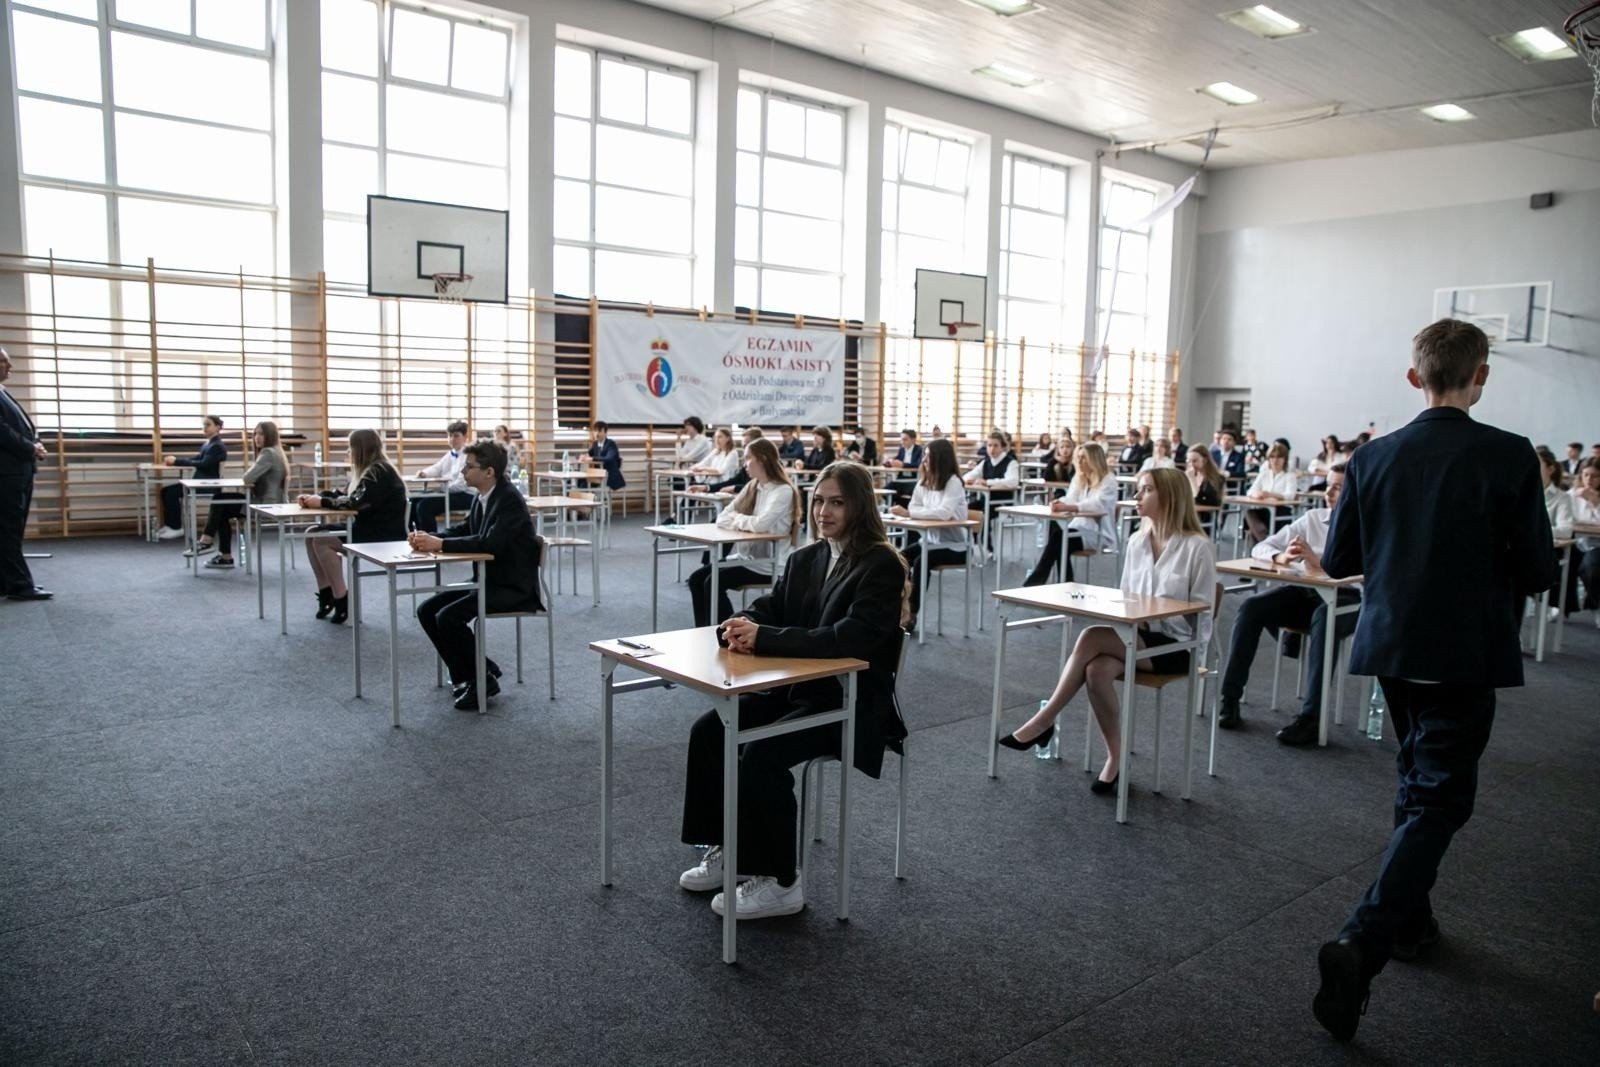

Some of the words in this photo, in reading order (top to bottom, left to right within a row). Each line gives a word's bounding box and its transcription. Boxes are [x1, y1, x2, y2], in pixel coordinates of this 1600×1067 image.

[747, 337, 814, 352] EGZAMIN
[722, 351, 834, 372] ÓSMOKLASISTY
[730, 374, 756, 386] Szkoła
[758, 375, 805, 388] Podstawowa
